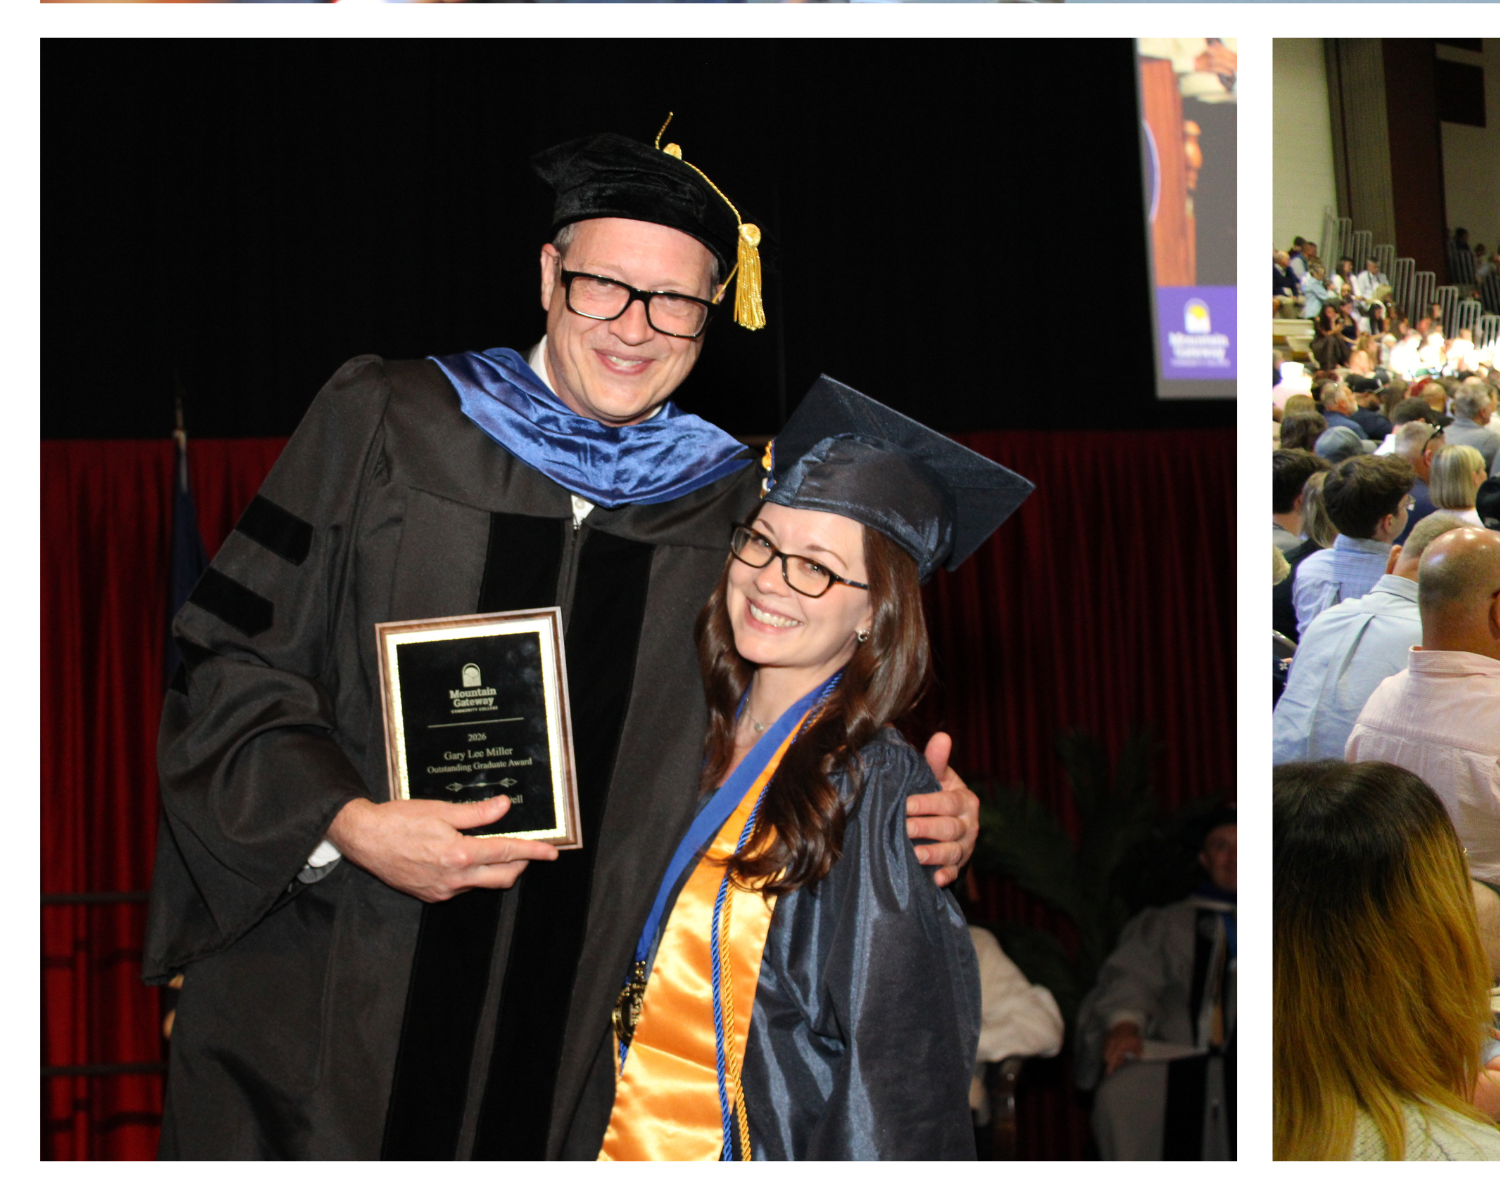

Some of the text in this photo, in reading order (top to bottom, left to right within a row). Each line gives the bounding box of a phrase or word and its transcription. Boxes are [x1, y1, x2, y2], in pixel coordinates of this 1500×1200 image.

[449, 687, 497, 699] Mountain
[453, 697, 495, 708] Gateway
[467, 733, 487, 742] 2026
[443, 747, 514, 762] Gary Lee Miller
[427, 757, 533, 774] Outstanding Graduate Award
